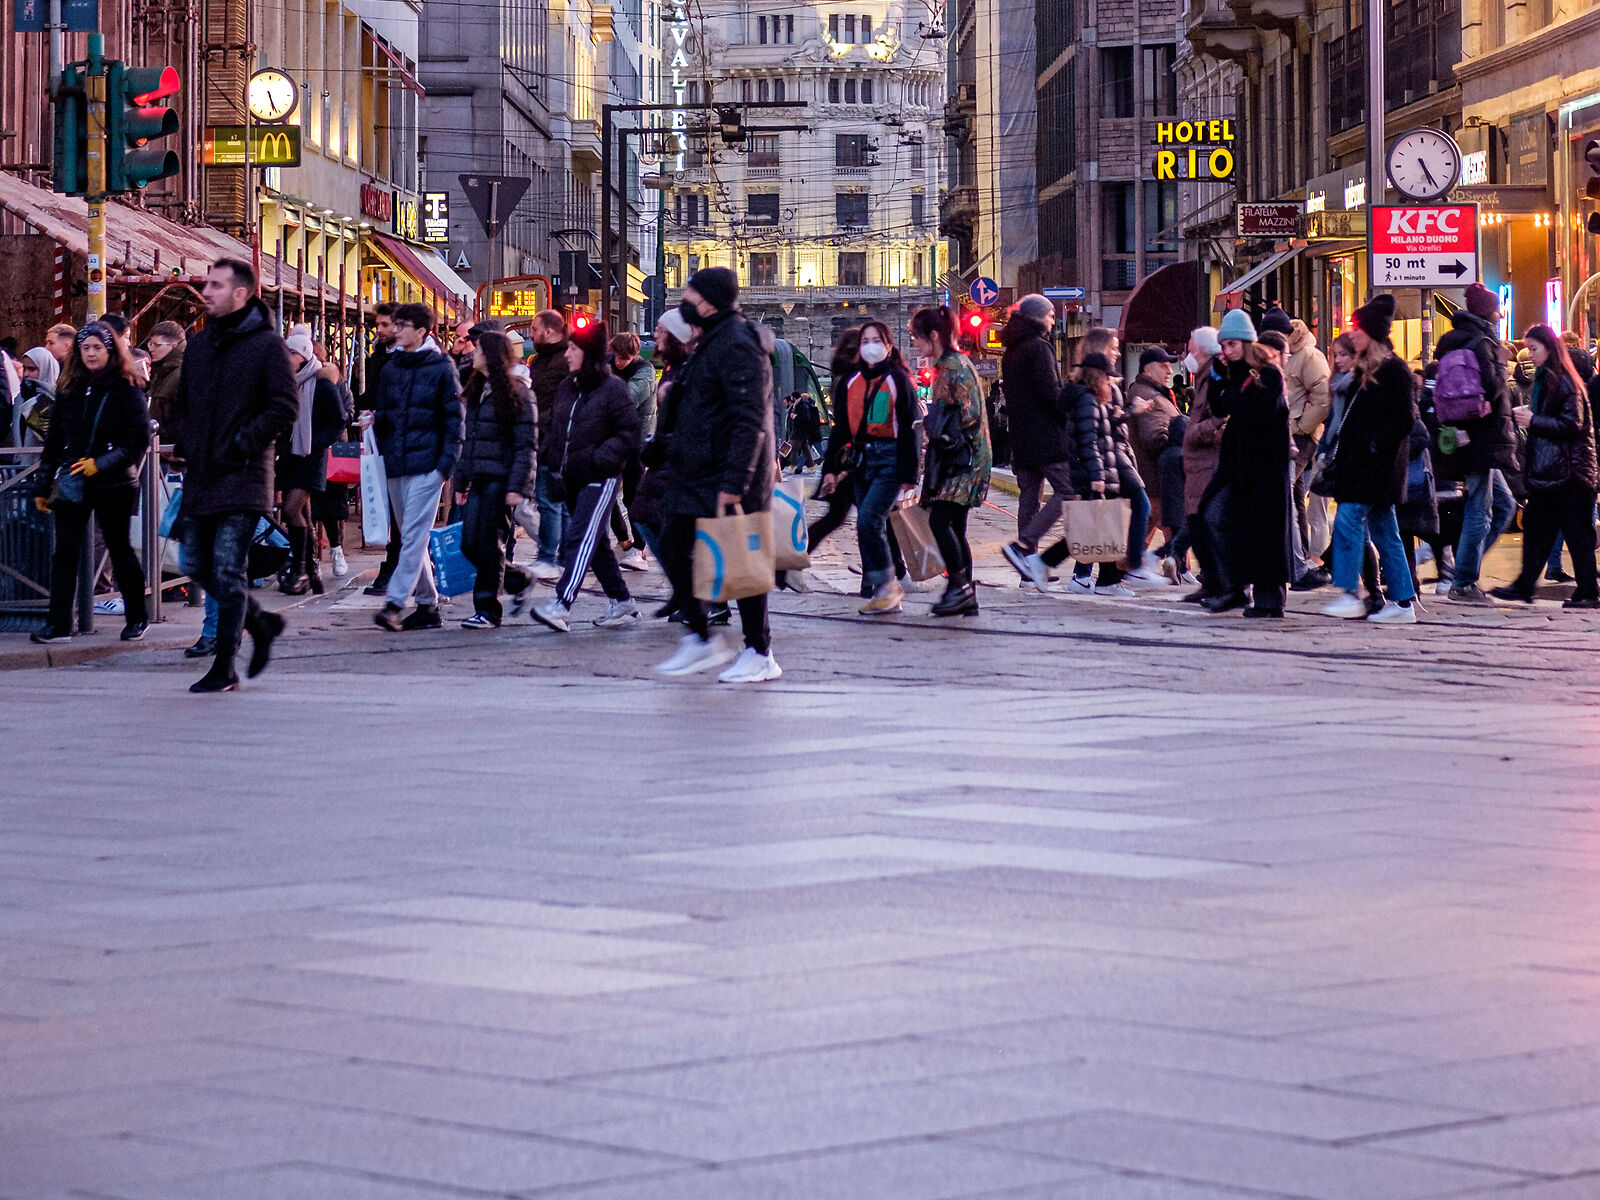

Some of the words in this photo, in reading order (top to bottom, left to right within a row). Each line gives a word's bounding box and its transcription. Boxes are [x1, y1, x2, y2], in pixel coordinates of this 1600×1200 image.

[1157, 119, 1235, 143] HOTEL
[1157, 148, 1234, 180] RIO
[1244, 208, 1279, 217] FILATELIA
[1258, 217, 1296, 226] MAZZINI
[1386, 209, 1460, 234] KFC
[1391, 236, 1425, 244] MILANO
[1426, 235, 1458, 244] DUOMO
[1418, 244, 1442, 252] Orefici
[1385, 257, 1401, 269] 50
[1407, 257, 1426, 269] mt
[1071, 541, 1128, 556] Bershka
